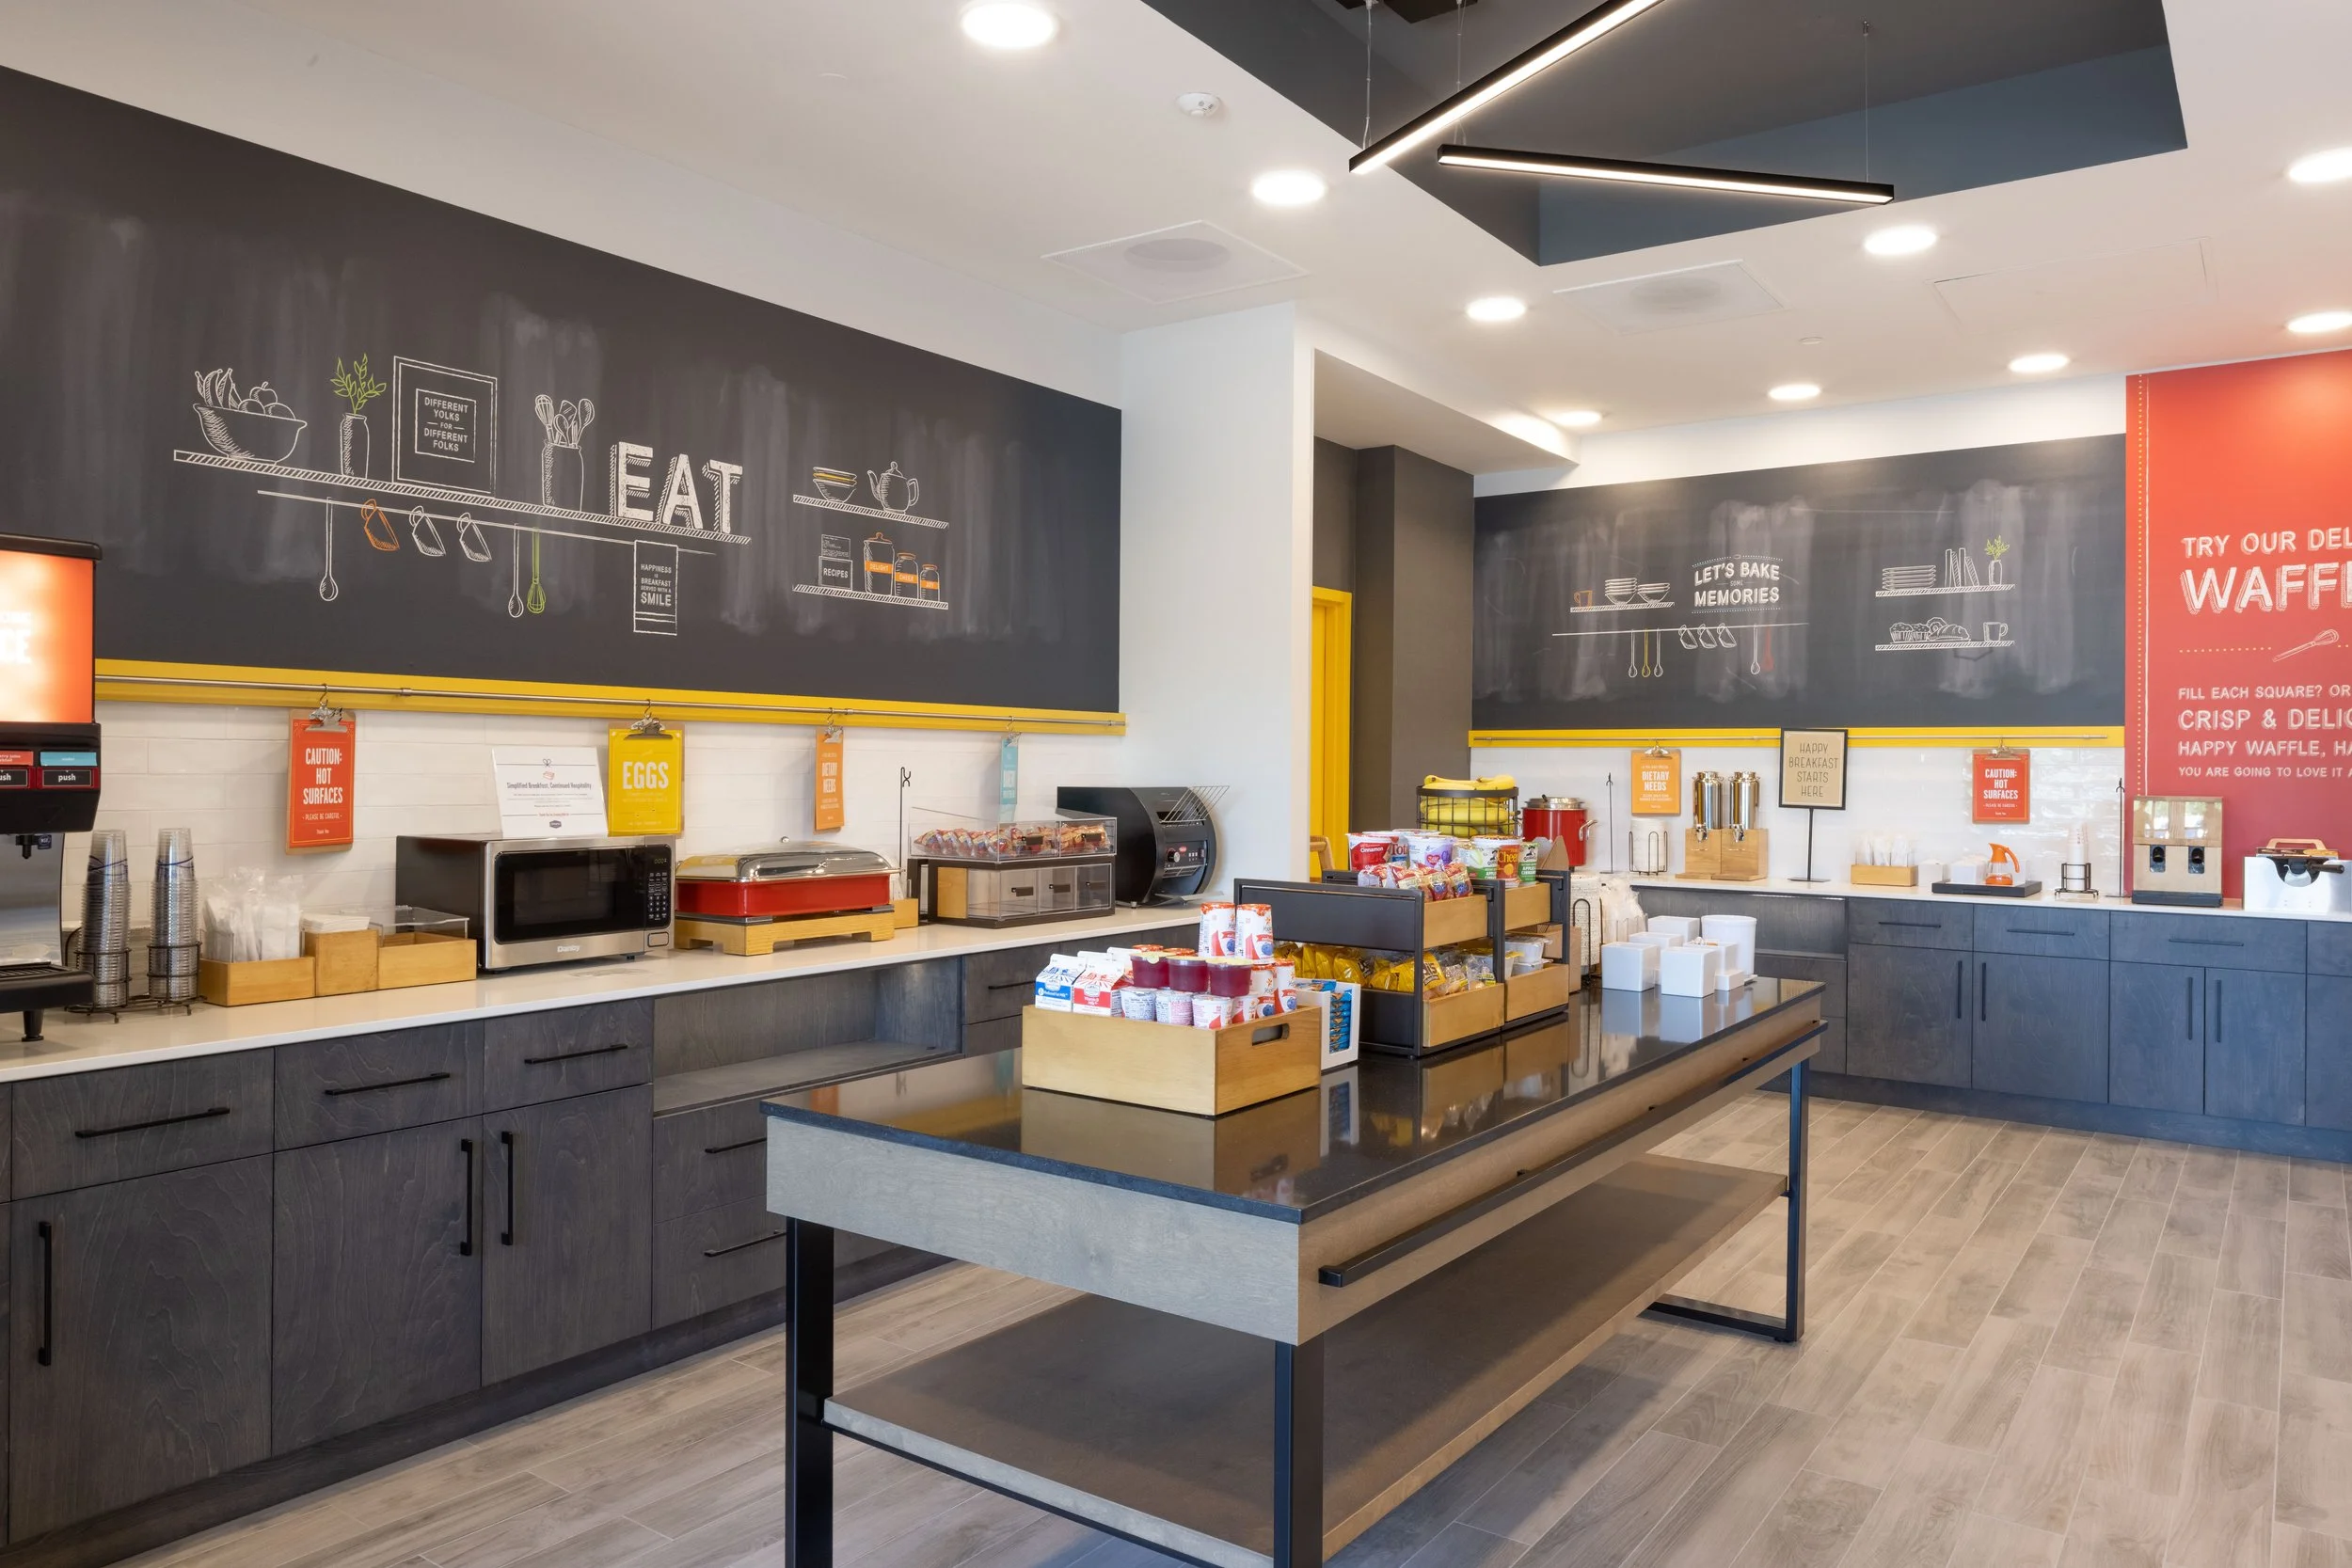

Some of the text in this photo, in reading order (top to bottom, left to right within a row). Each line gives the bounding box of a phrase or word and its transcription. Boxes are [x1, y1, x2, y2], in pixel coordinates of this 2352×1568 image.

[424, 397, 469, 413] DIFFERENT
[434, 409, 460, 421] YOLKS
[424, 428, 468, 443] DIFFERENT
[433, 440, 459, 451] FOLKS
[611, 442, 743, 534] EAT
[2181, 534, 2230, 558] TRY
[2241, 531, 2296, 555] OUR
[641, 563, 672, 574] HAPPINESS
[823, 567, 849, 579] RECIPES
[1694, 562, 1780, 586] LET'S BAKE
[641, 577, 672, 587] BREAKFAST
[641, 592, 672, 607] SMILE
[1694, 587, 1780, 607] MEMORIES
[2178, 685, 2351, 700] FILL EACH SQUARE? OR
[2178, 709, 2250, 730] CRISP
[2262, 708, 2277, 730] &
[1800, 743, 1829, 753] HAPPY
[2178, 740, 2237, 756] HAPPY
[2246, 740, 2326, 757] WAFFLE,
[306, 747, 342, 766] CAUTION:
[1788, 756, 1838, 768] BREAKFAST
[58, 773, 76, 783] push
[316, 768, 332, 785] HOT
[623, 761, 669, 789] EGGS
[1642, 770, 1670, 781] DIETARY
[1797, 771, 1829, 783] STARTS
[1984, 768, 2017, 779] CAUTION:
[2179, 767, 2201, 778] YOU
[2205, 767, 2229, 778] ARE
[2233, 767, 2271, 778] GOING
[2277, 767, 2292, 778] TO
[2296, 767, 2328, 778] LOVE
[2332, 767, 2343, 778] IT
[1644, 781, 1667, 791] NEEDS
[1994, 779, 2008, 789] HOT
[303, 787, 343, 805] SURFACES
[1801, 785, 1823, 798] HERE
[1983, 789, 2018, 800] SURFACES
